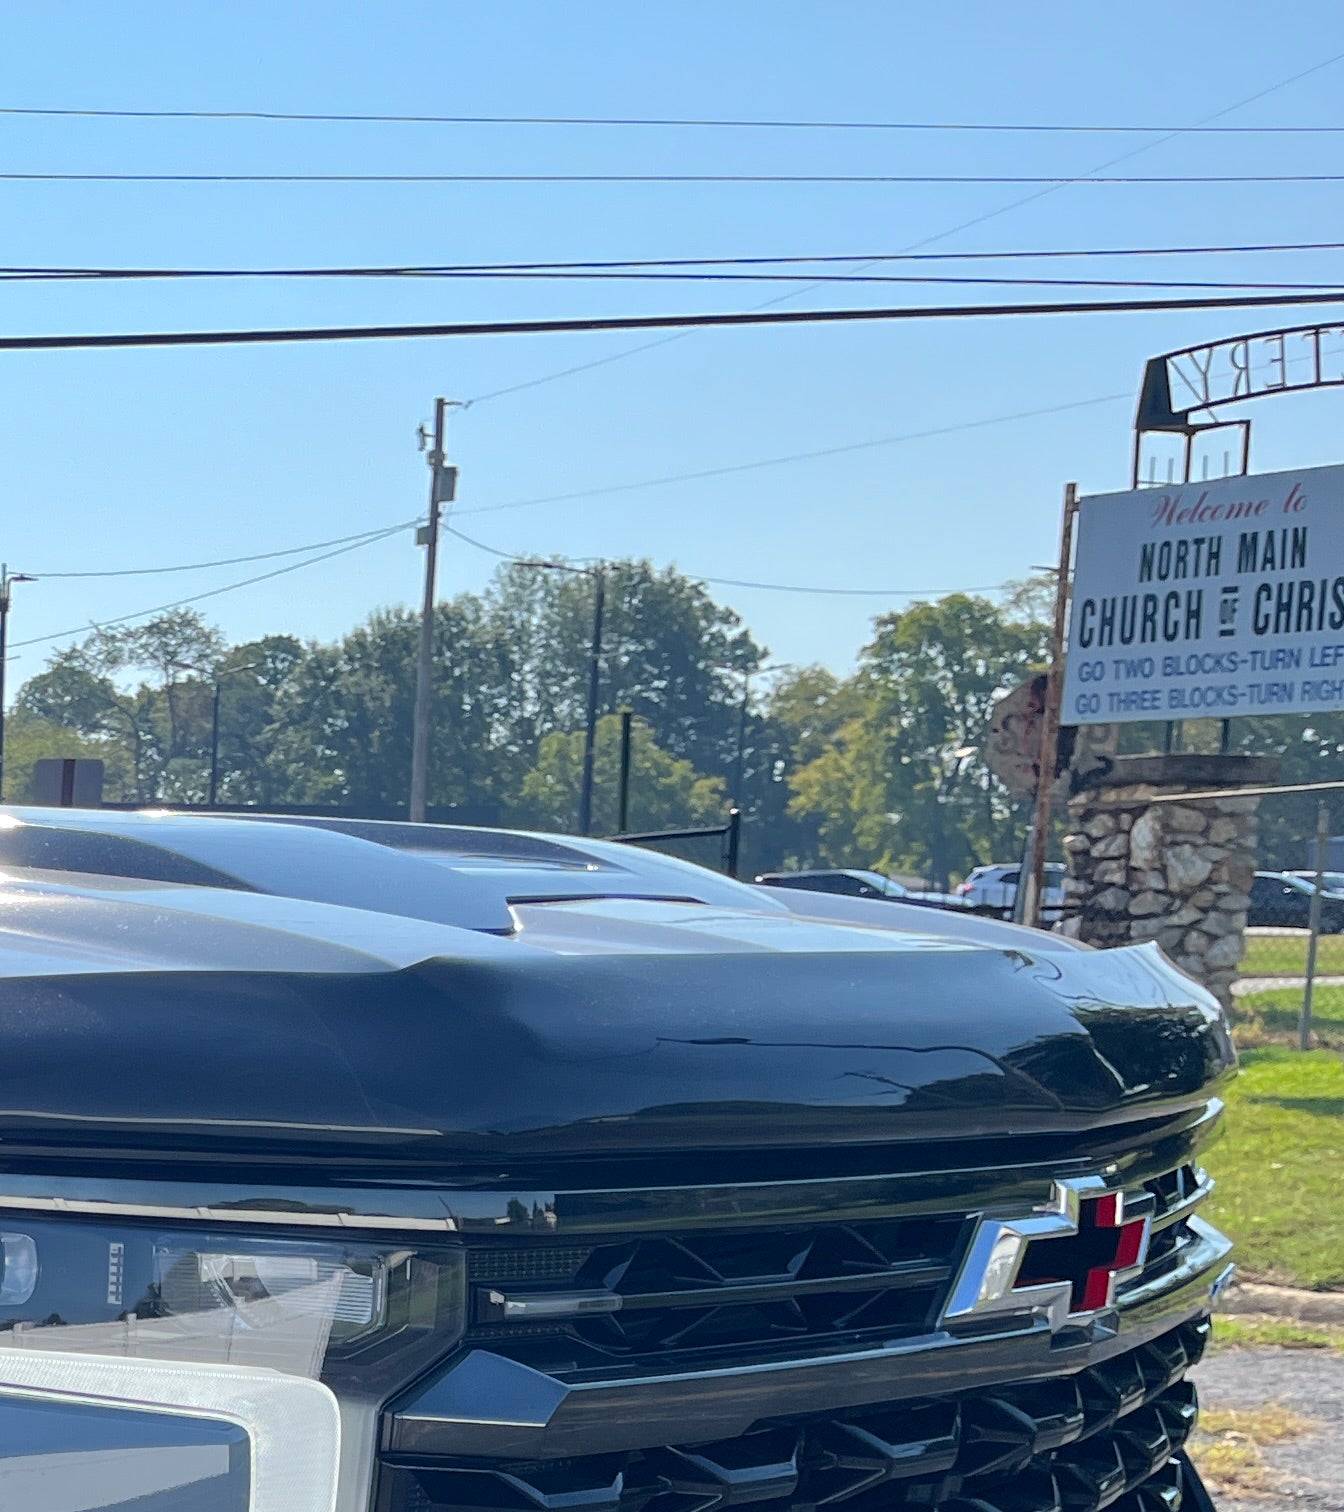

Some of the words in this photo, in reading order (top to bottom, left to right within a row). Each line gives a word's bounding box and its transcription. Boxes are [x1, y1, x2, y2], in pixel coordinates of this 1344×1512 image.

[1152, 491, 1269, 528] Welcome
[1283, 482, 1307, 513] to
[1138, 535, 1222, 584] NORTH
[1237, 526, 1308, 574] MAIN
[1079, 589, 1203, 648] CHURCH
[1078, 661, 1105, 682] GO
[1113, 657, 1154, 680] TWO
[1075, 693, 1101, 714] GO
[1108, 690, 1161, 712] THREE
